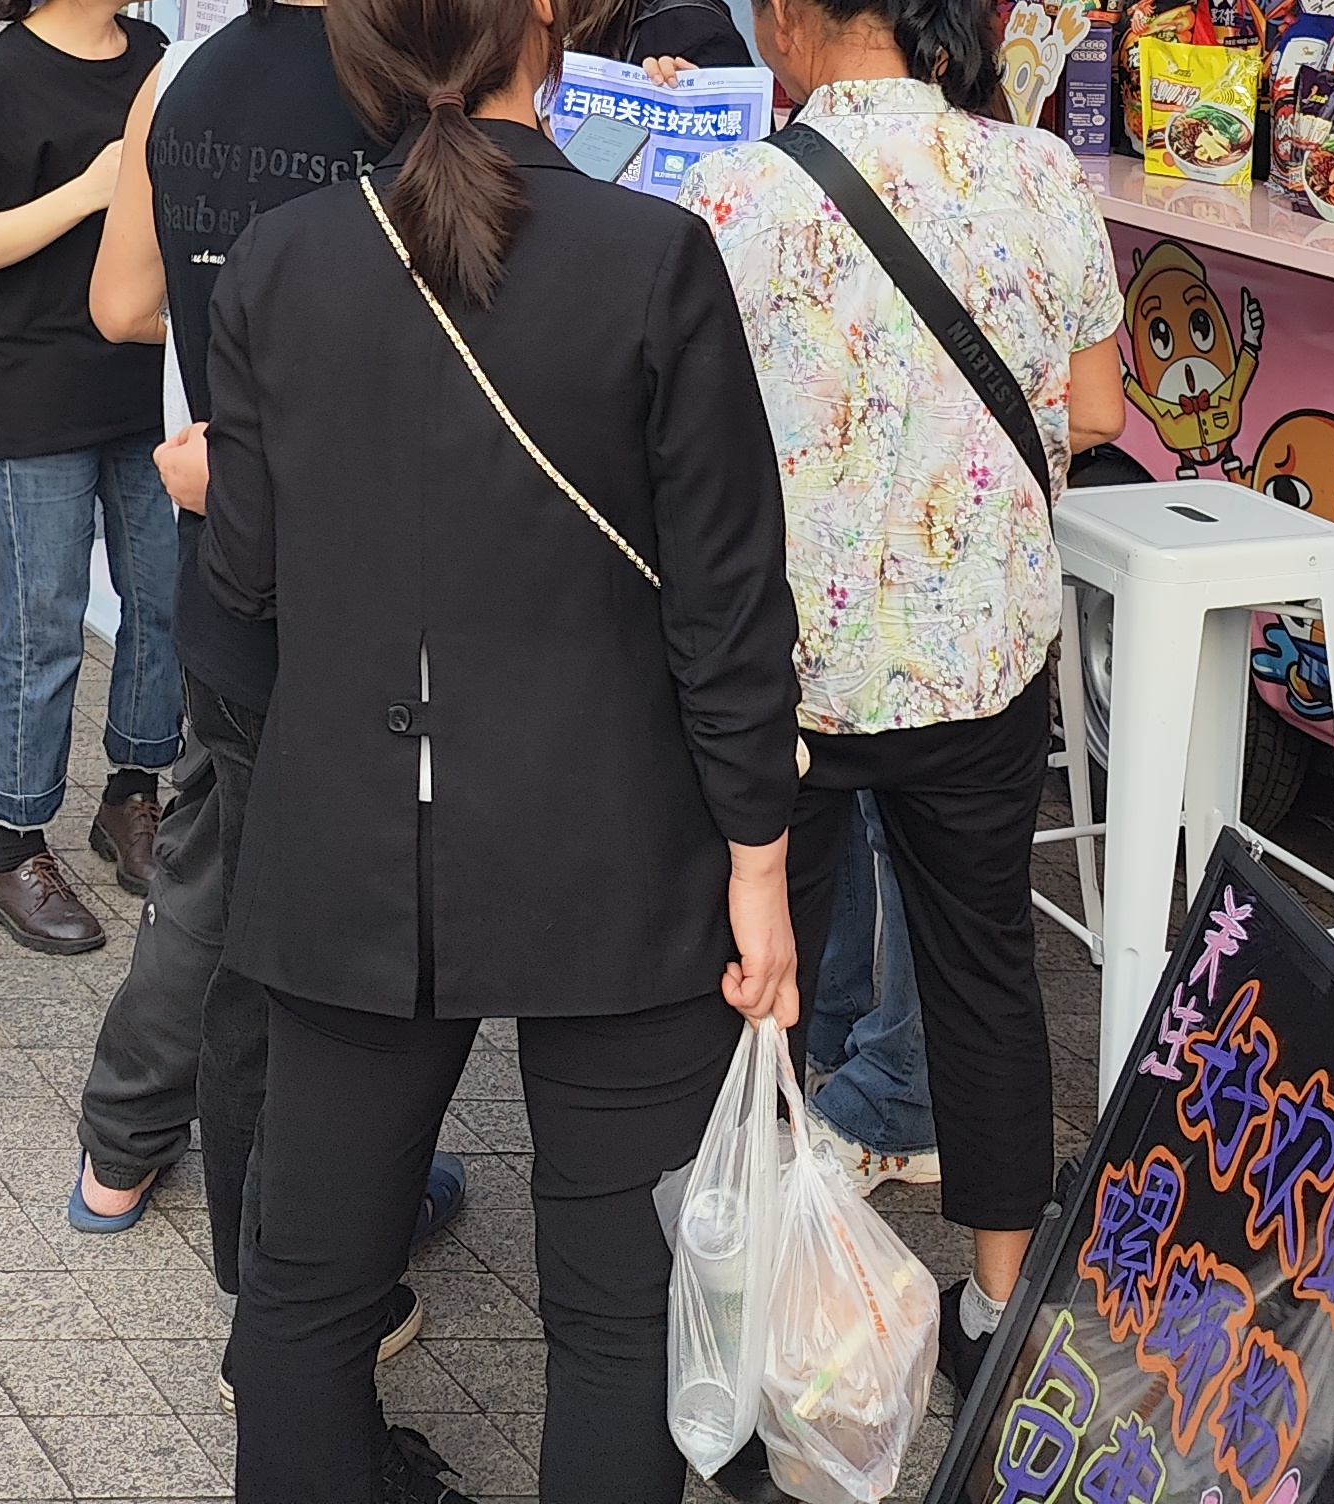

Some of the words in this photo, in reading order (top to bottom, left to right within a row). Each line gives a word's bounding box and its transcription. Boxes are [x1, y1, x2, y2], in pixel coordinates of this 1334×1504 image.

[564, 88, 742, 136] 扫码关注好欢螺
